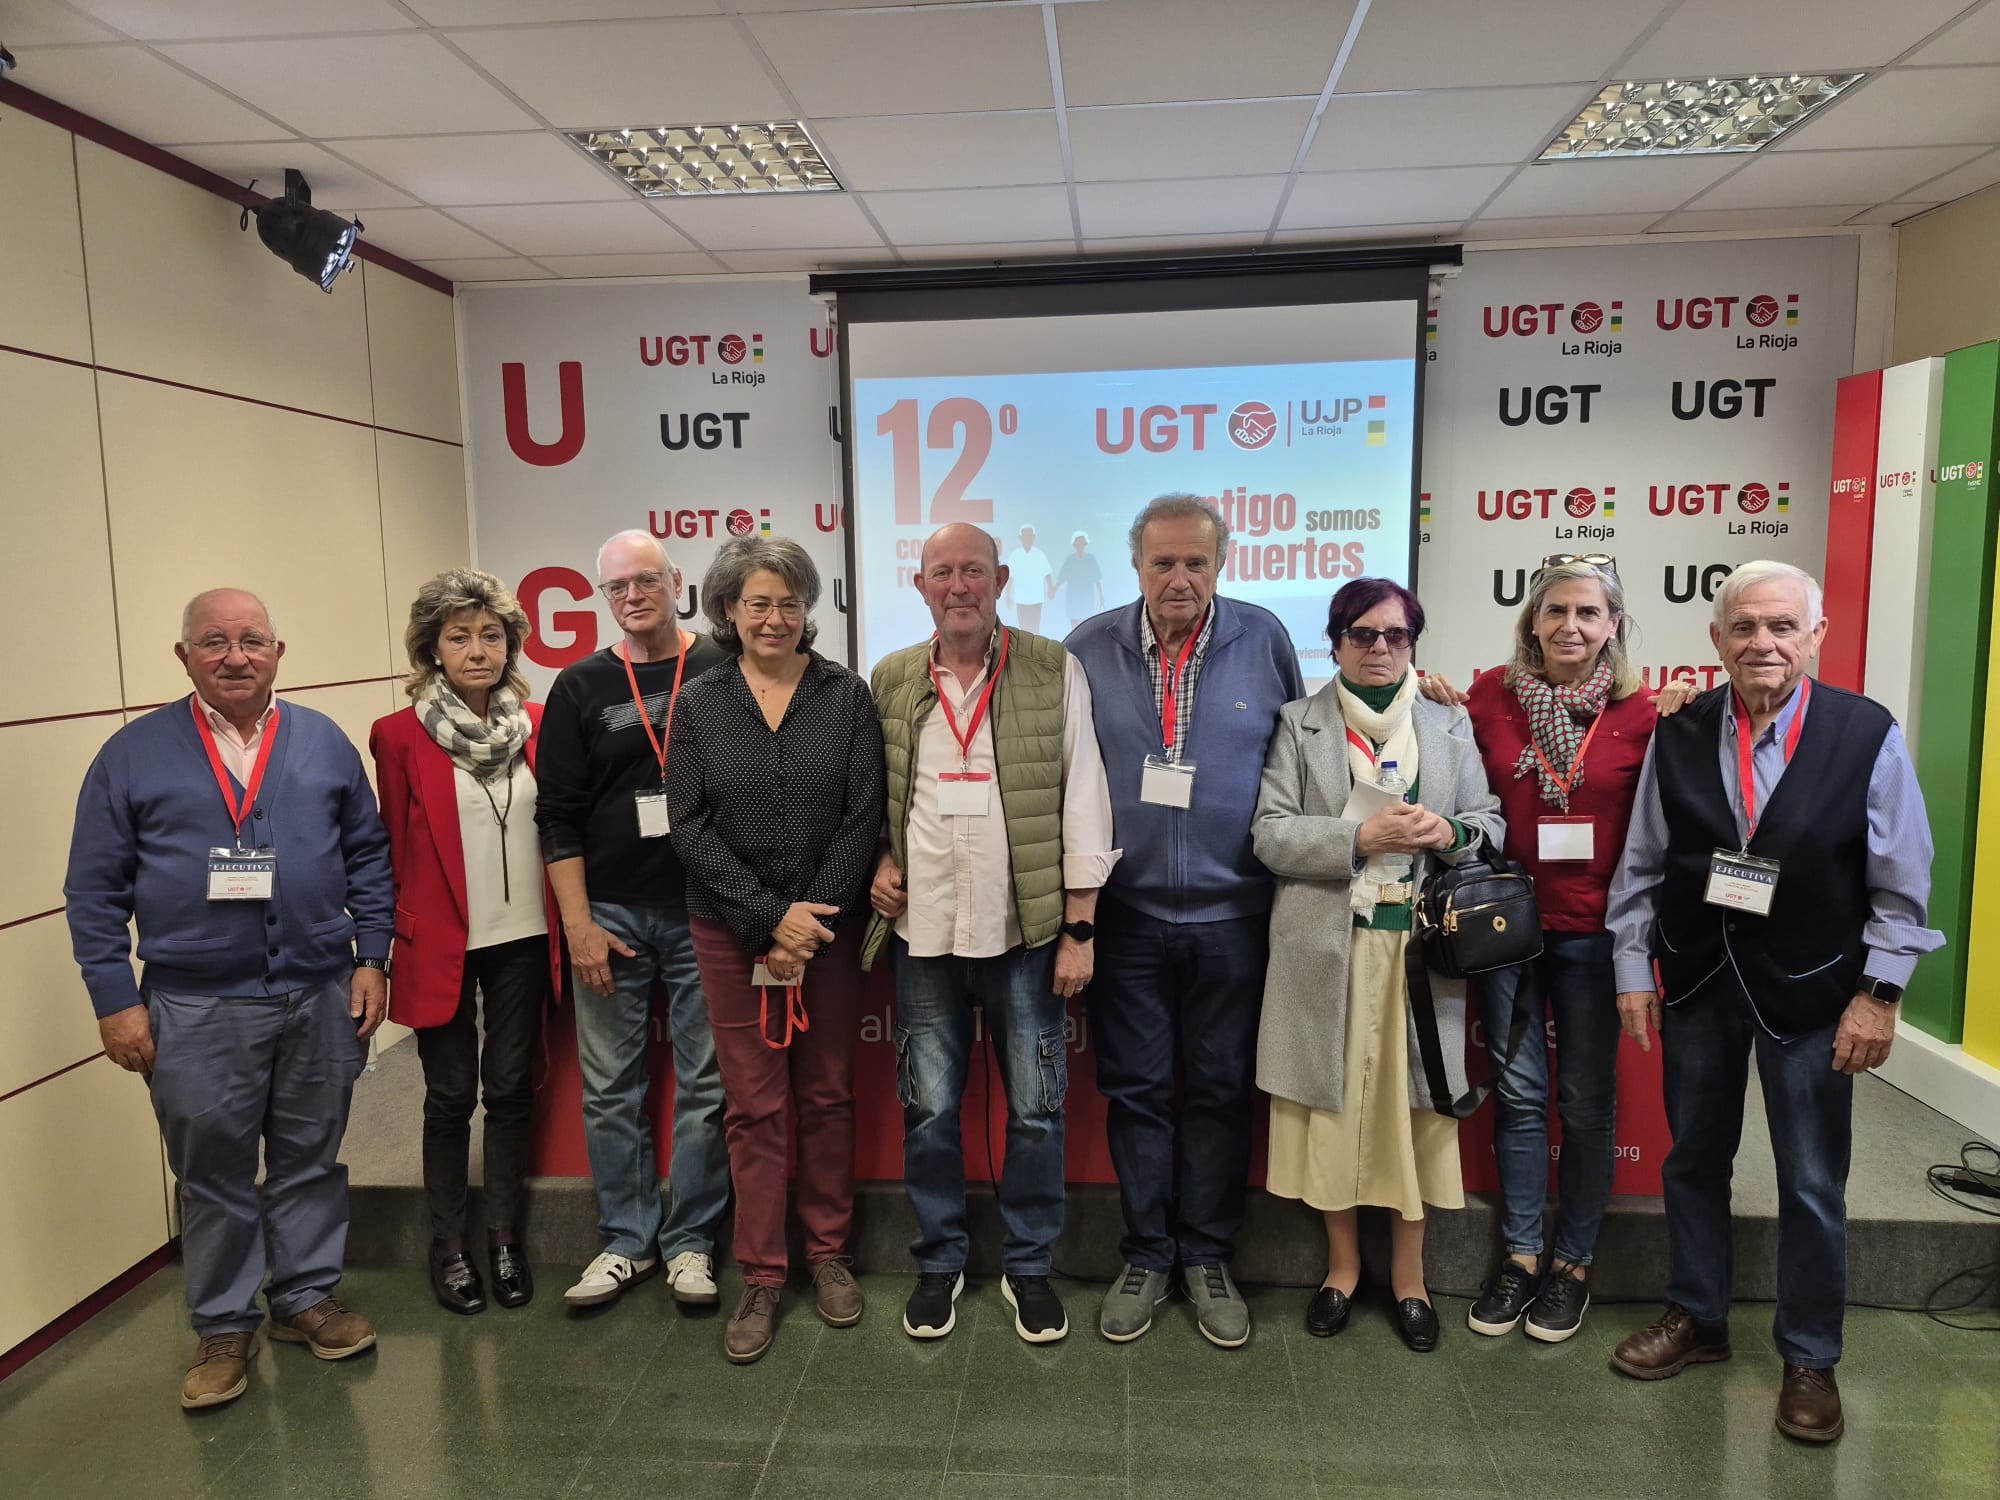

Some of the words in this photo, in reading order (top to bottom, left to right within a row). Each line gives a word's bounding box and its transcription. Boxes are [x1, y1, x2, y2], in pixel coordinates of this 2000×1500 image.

[1483, 303, 1564, 338] UGT
[1658, 297, 1739, 331] UGT
[639, 335, 711, 366] UGT
[1562, 342, 1580, 355] La
[1584, 340, 1622, 357] Rioja
[1736, 335, 1755, 349] La
[1759, 334, 1798, 351] Rioja
[712, 371, 728, 385] La
[731, 371, 766, 388] Rioja
[1499, 384, 1601, 427] UGT
[1671, 378, 1777, 420] UGT
[660, 412, 750, 450] UGT
[1095, 403, 1218, 454] UGT
[1301, 398, 1363, 424] UJP
[1301, 427, 1314, 436] La
[1316, 421, 1342, 436] Rioja
[1833, 479, 1851, 494] UGT
[1880, 473, 1900, 488] UGT
[1941, 464, 1965, 481] UGT
[1203, 486, 1297, 537] tigo
[1305, 508, 1381, 532] somos
[1477, 489, 1558, 521] UGT
[1649, 484, 1731, 516] UGT
[649, 509, 719, 539] UGT
[1555, 526, 1573, 539] La
[1577, 525, 1615, 541] Rioja
[1728, 522, 1746, 534] La
[1750, 520, 1789, 537] Rioja
[1226, 537, 1365, 582] fuertes
[1664, 563, 1741, 604] UG
[1642, 665, 1723, 694] UGT
[1715, 865, 1772, 883] EJECUTIVA
